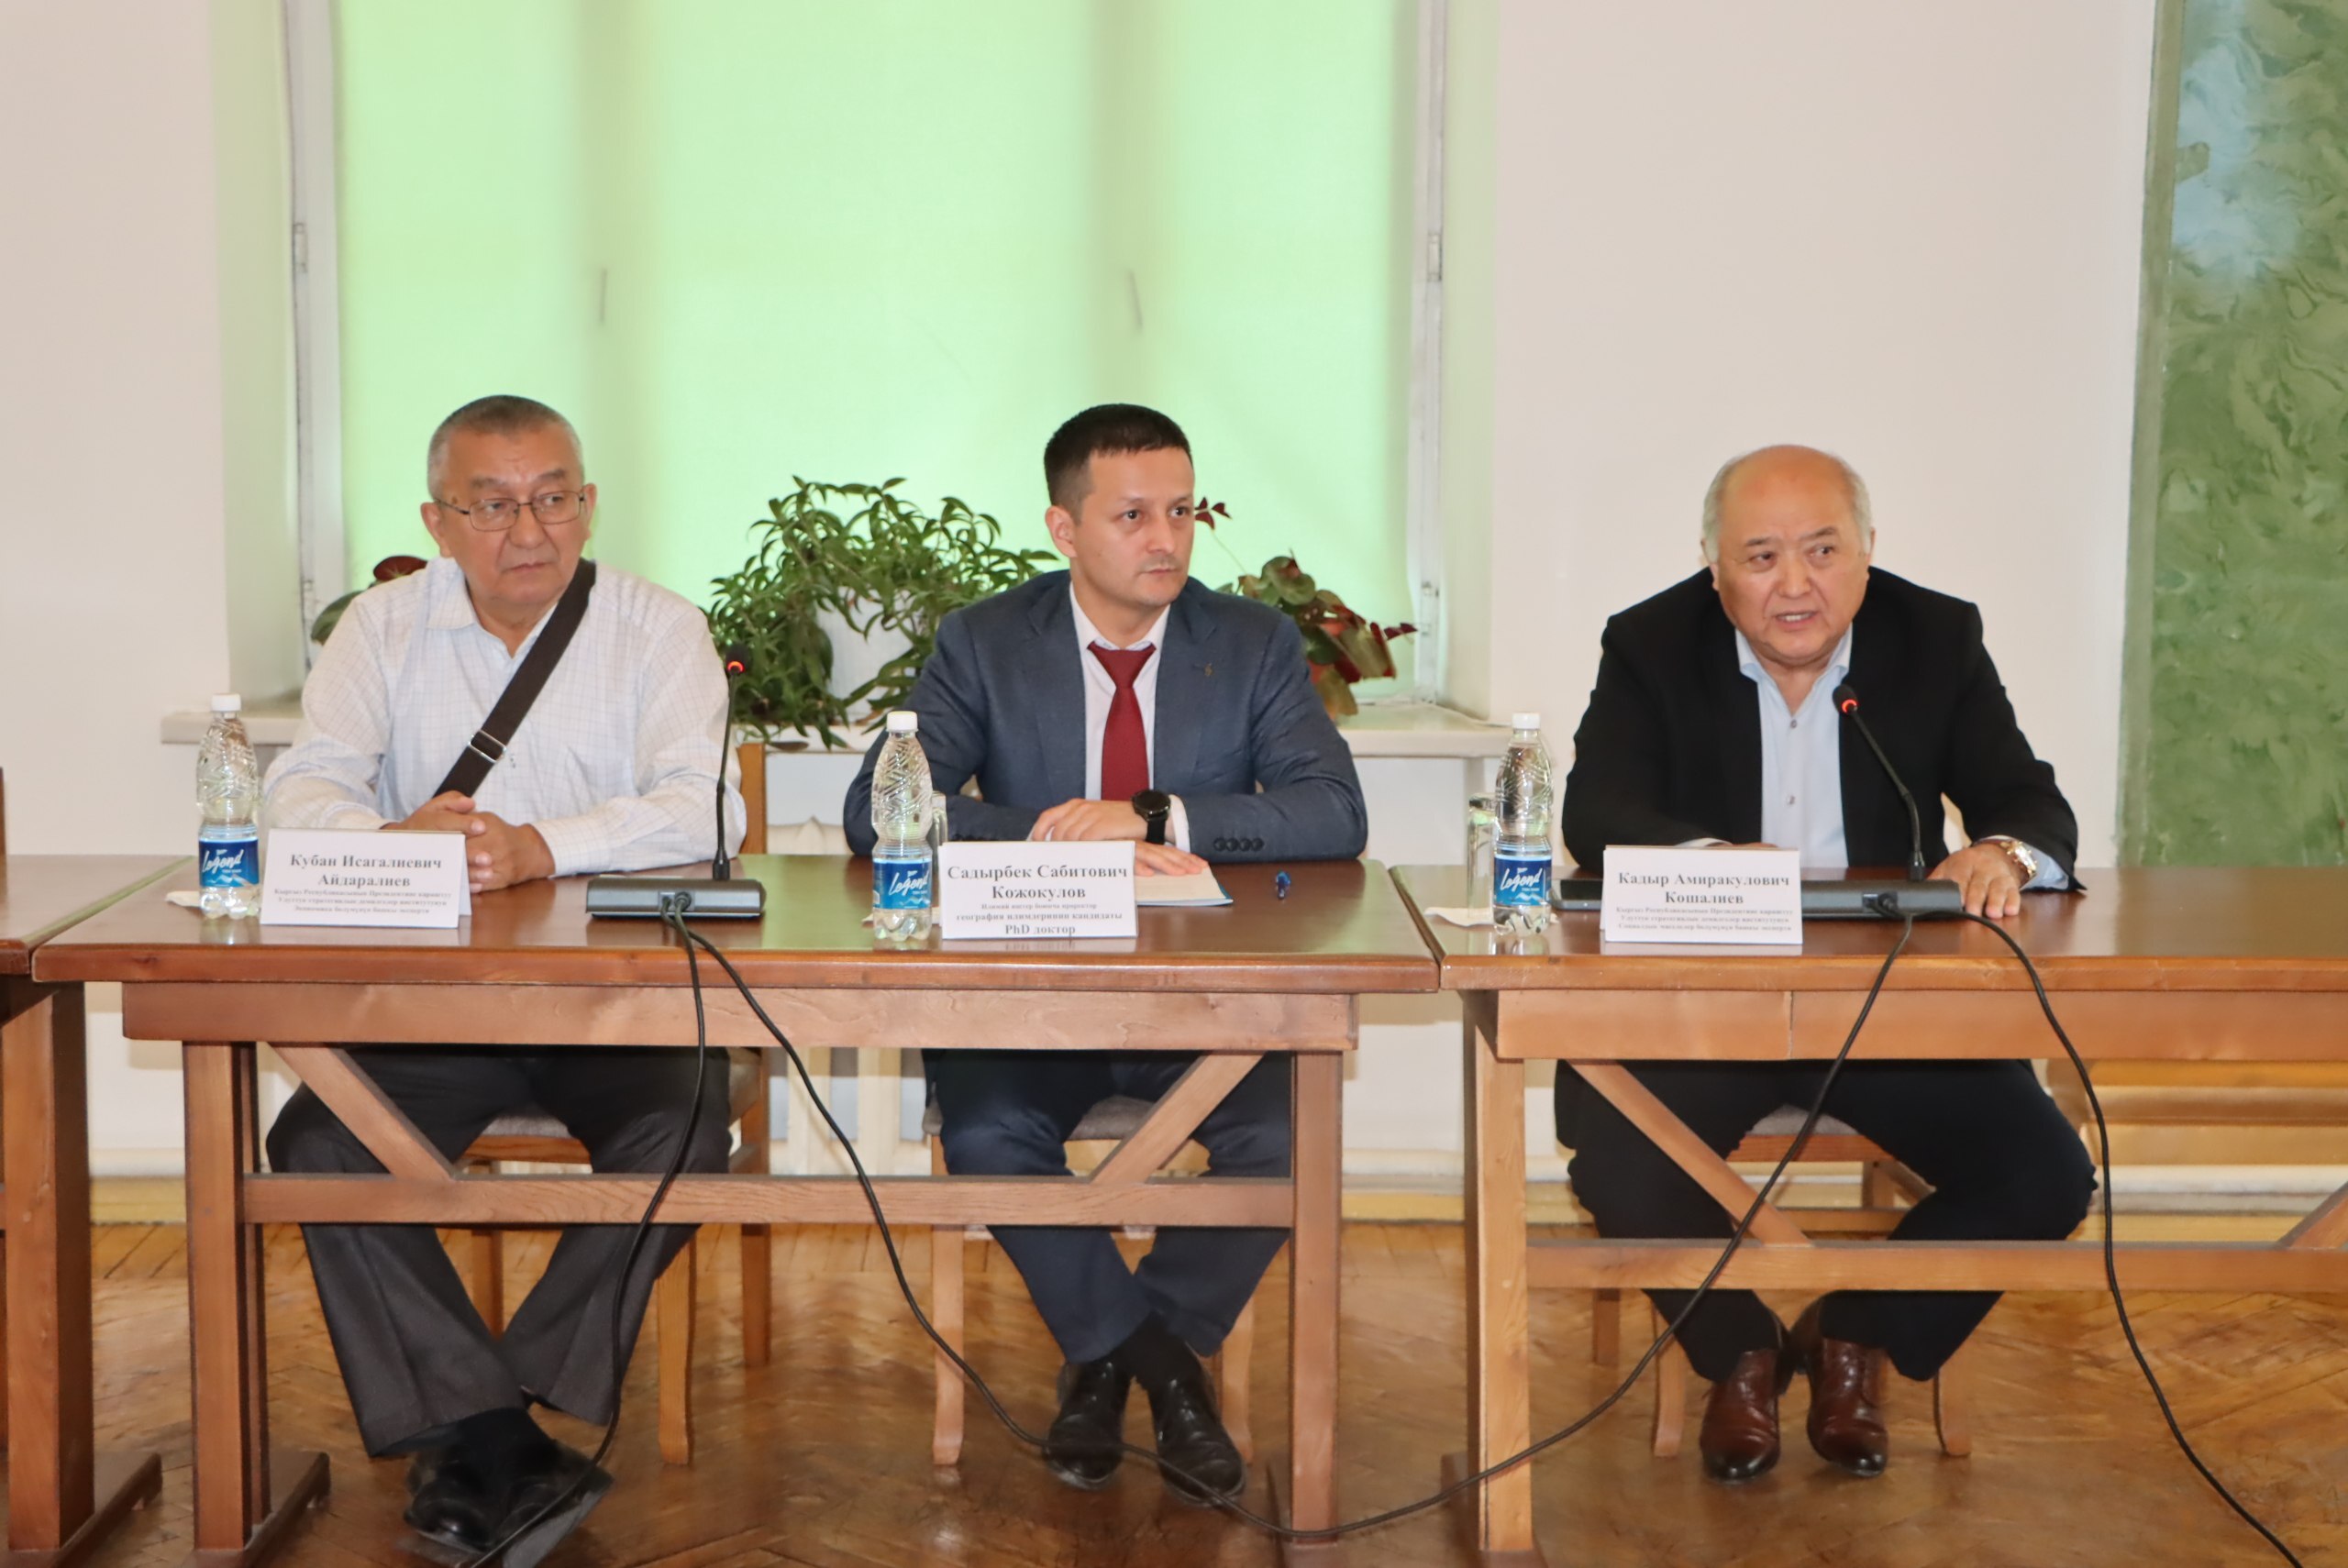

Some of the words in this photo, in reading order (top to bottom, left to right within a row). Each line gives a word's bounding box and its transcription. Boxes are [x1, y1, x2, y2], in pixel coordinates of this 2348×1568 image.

[202, 849, 244, 874] Legend
[290, 854, 337, 869] Кубан
[342, 856, 442, 868] Исагалиевич
[947, 865, 1032, 881] Садырбек
[1037, 864, 1127, 878] Сабитович
[1500, 867, 1543, 892] Legend
[1619, 872, 1669, 888] Кадыр
[1674, 874, 1789, 889] Амиракулович
[317, 873, 411, 889] Айдаралиев
[889, 871, 929, 896] Legend
[991, 886, 1086, 901] Кожокулов
[1665, 891, 1744, 903] Кошалиев
[957, 912, 1004, 922] география
[1007, 912, 1069, 922] илимдеринин
[1004, 923, 1030, 934] PhD
[1033, 925, 1076, 936] доктор
